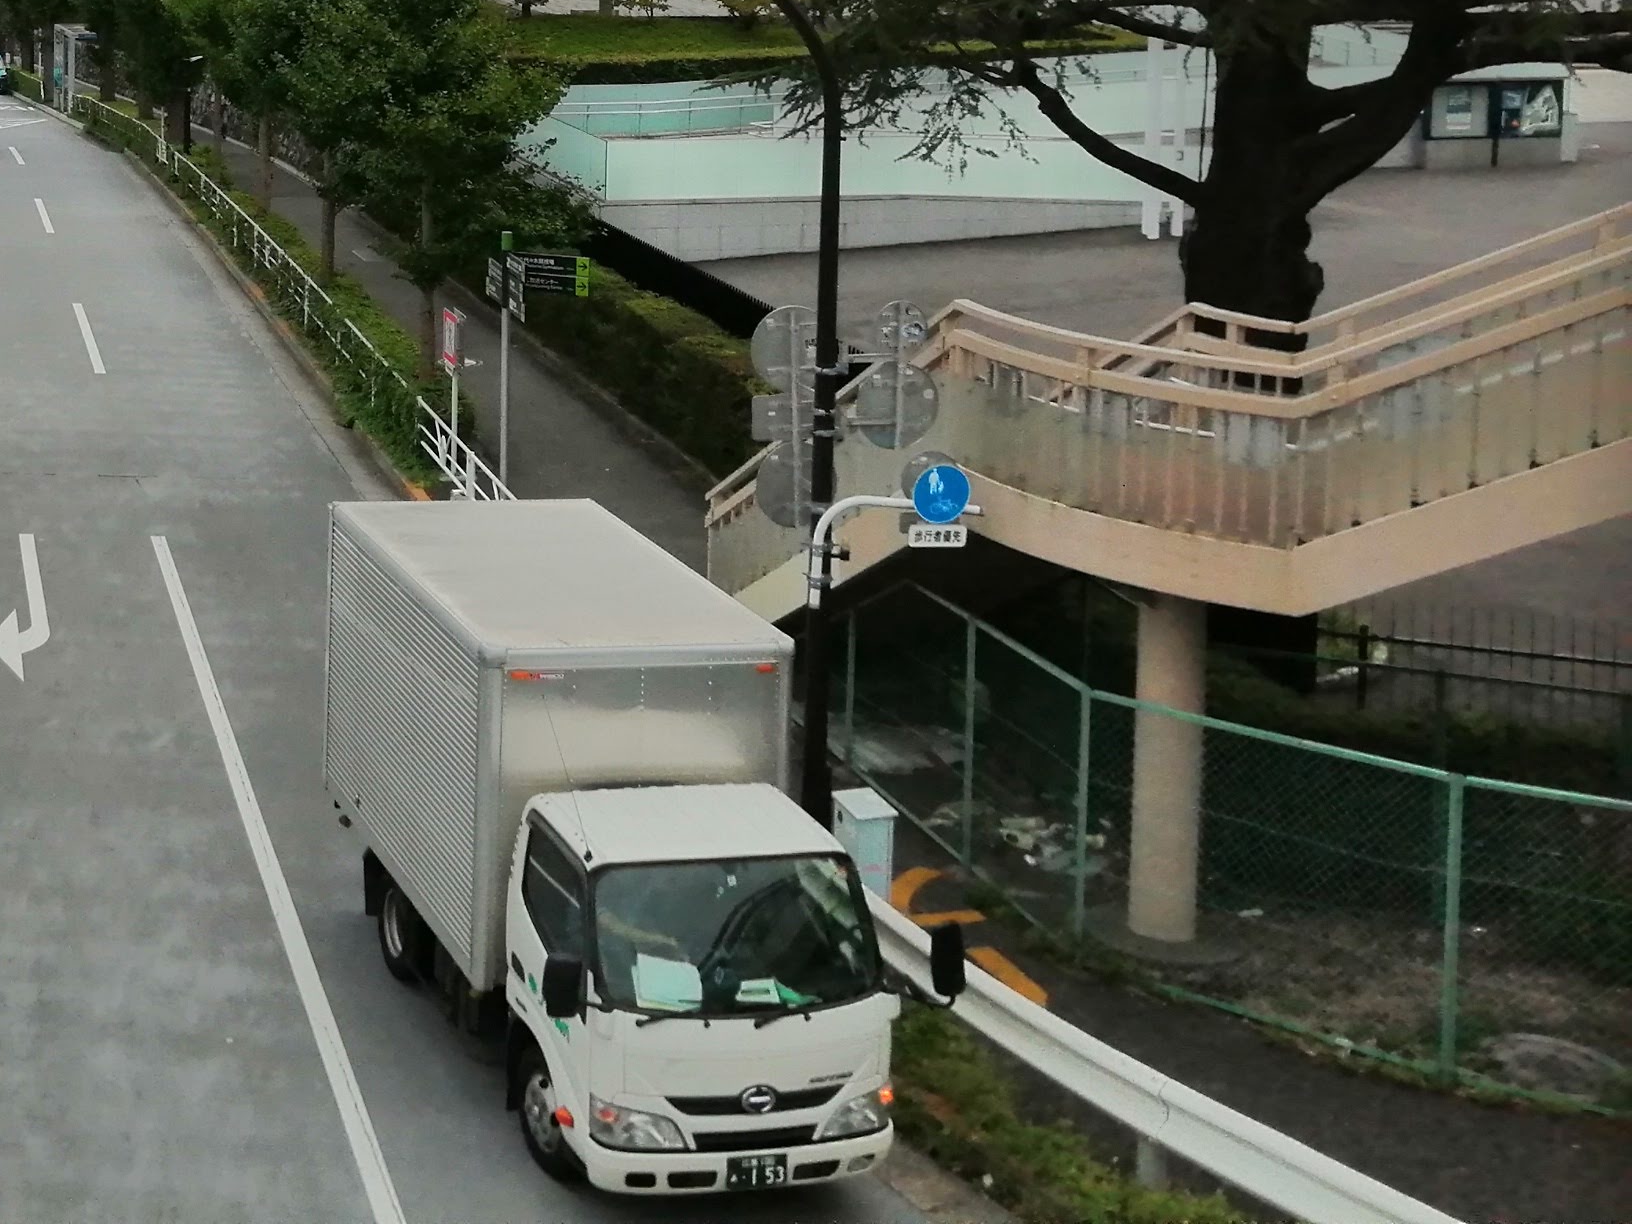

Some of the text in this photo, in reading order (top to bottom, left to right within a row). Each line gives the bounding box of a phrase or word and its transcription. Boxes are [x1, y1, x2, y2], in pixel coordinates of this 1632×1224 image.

[914, 530, 961, 543] 歩行者優先
